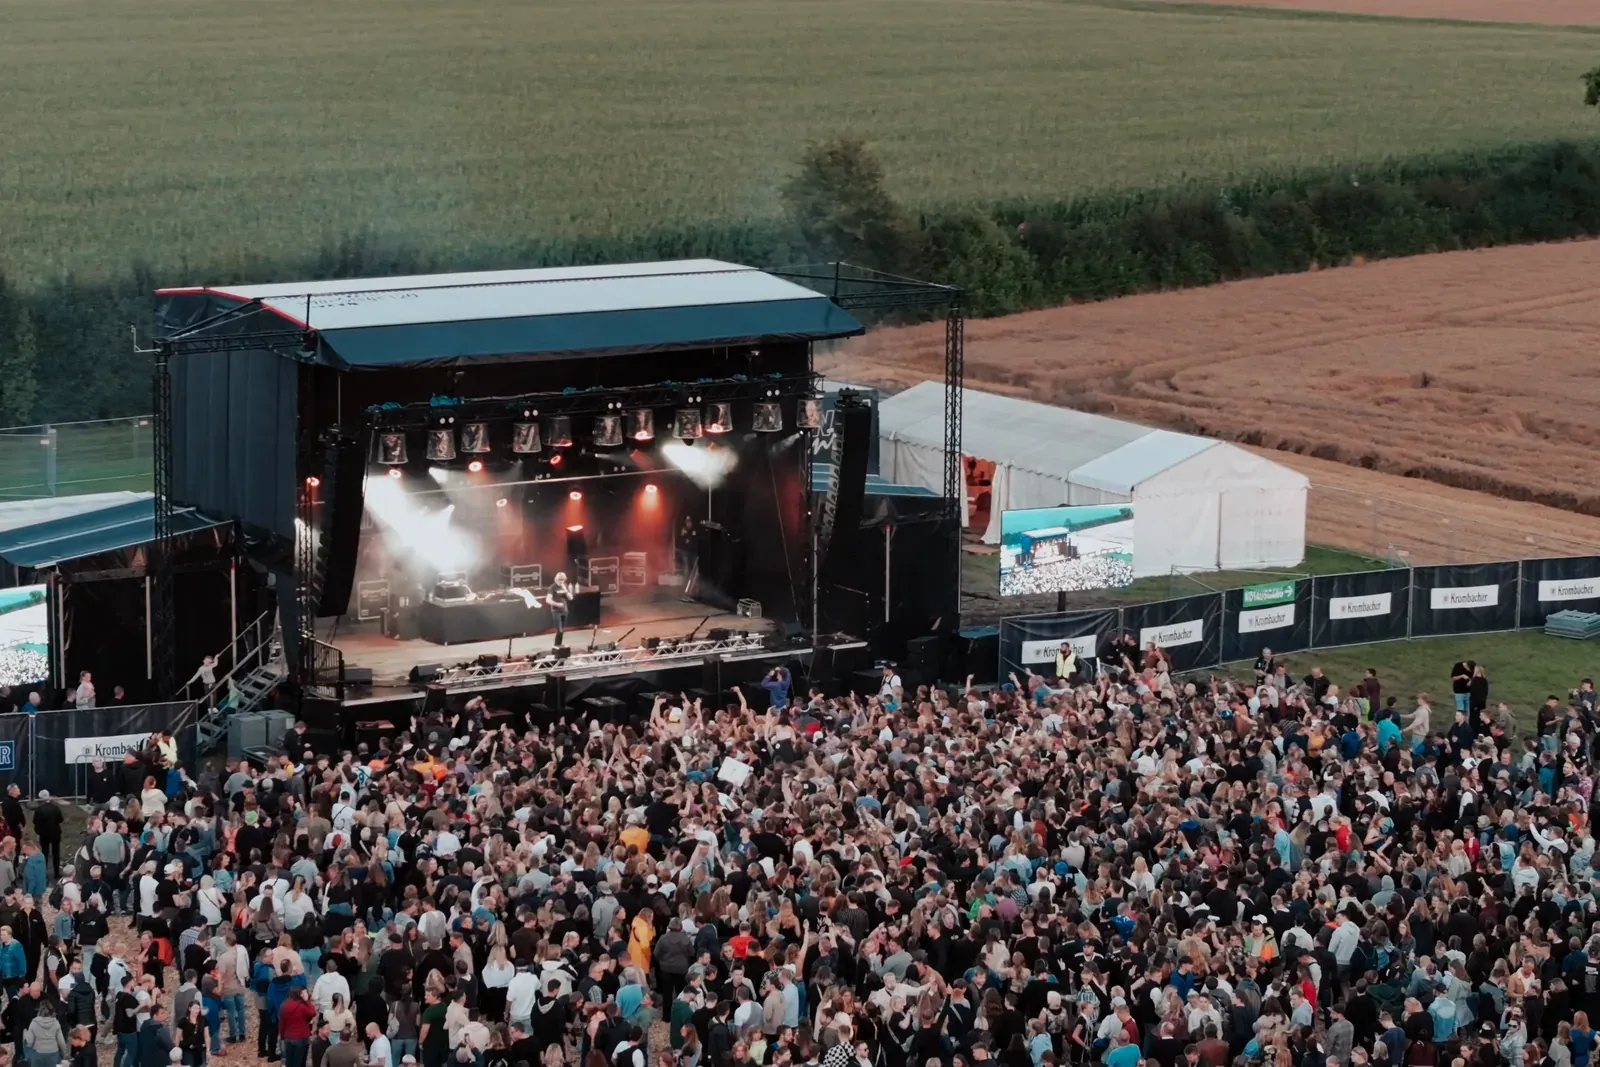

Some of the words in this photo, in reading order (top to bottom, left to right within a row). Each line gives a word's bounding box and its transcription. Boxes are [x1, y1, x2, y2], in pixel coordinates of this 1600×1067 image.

[1558, 584, 1594, 596] Krombacher
[1451, 592, 1488, 603] Krombacher
[1348, 600, 1381, 613] Krombacher
[1255, 613, 1286, 628] Krombacher
[1158, 629, 1193, 643] Krombacher
[1043, 643, 1085, 658] Kromher
[95, 740, 142, 756] Krombach
